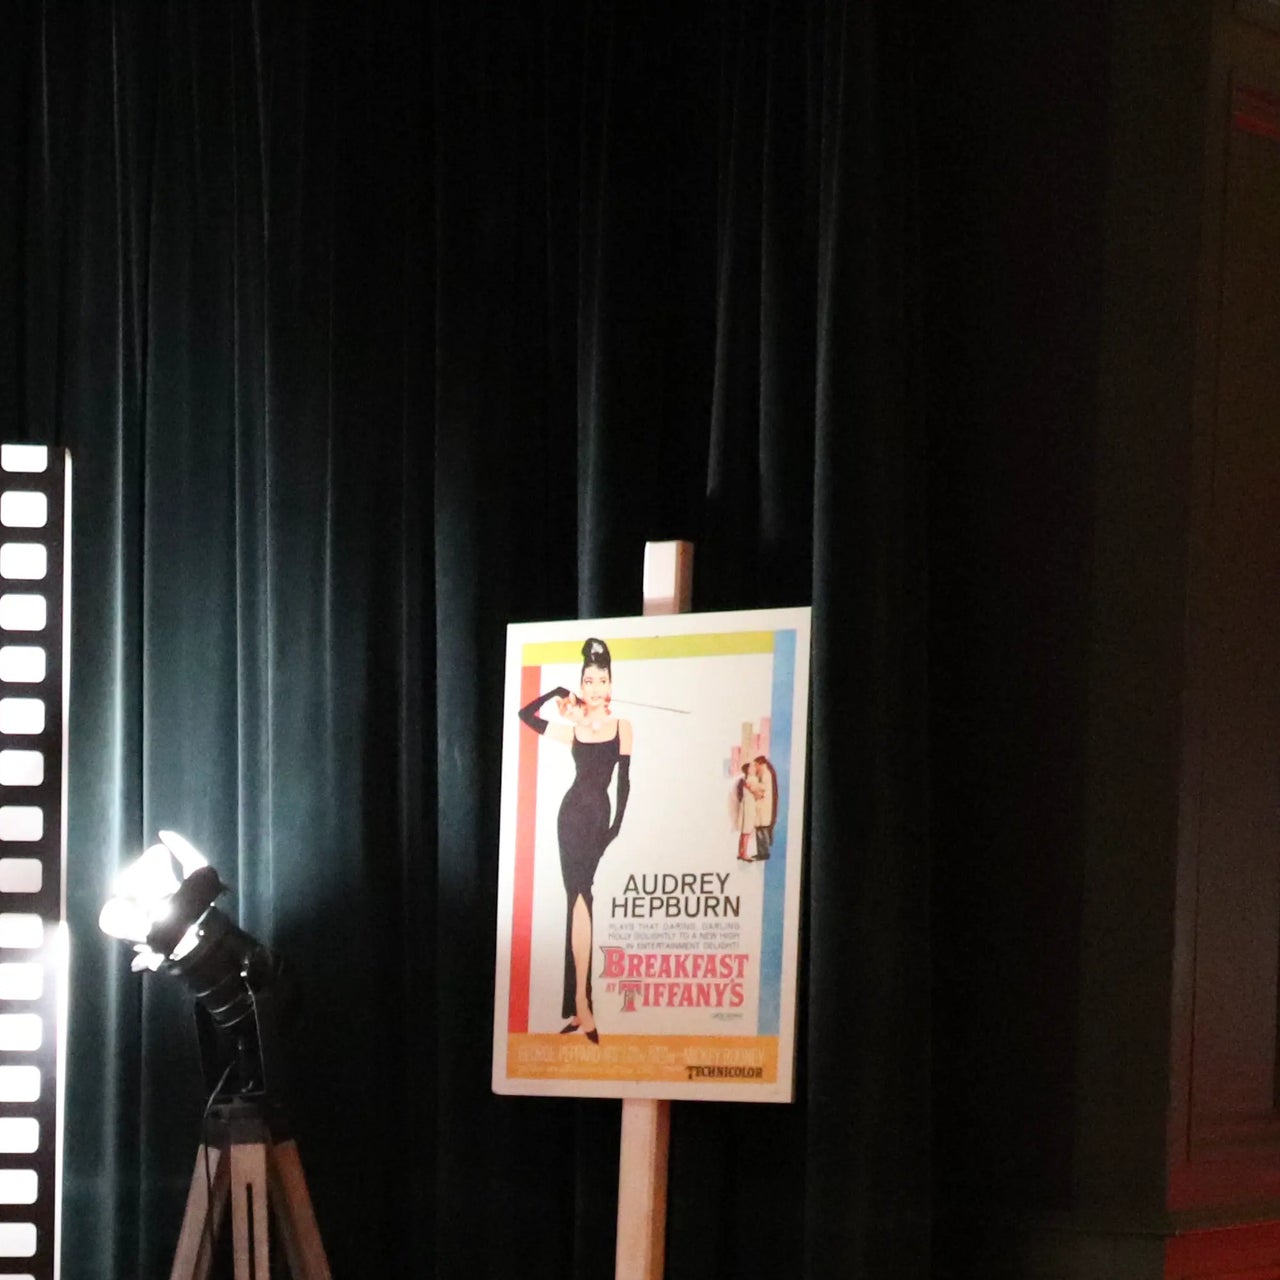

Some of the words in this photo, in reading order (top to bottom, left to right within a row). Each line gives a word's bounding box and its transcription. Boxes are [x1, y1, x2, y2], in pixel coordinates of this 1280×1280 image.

[623, 873, 730, 895] AUDREY
[612, 896, 740, 918] HEPBURN
[598, 946, 750, 979] BREAKFAST
[605, 983, 616, 993] AT
[618, 978, 745, 1013] TIFFANY'S
[685, 1065, 763, 1080] TECHNICOLOR
